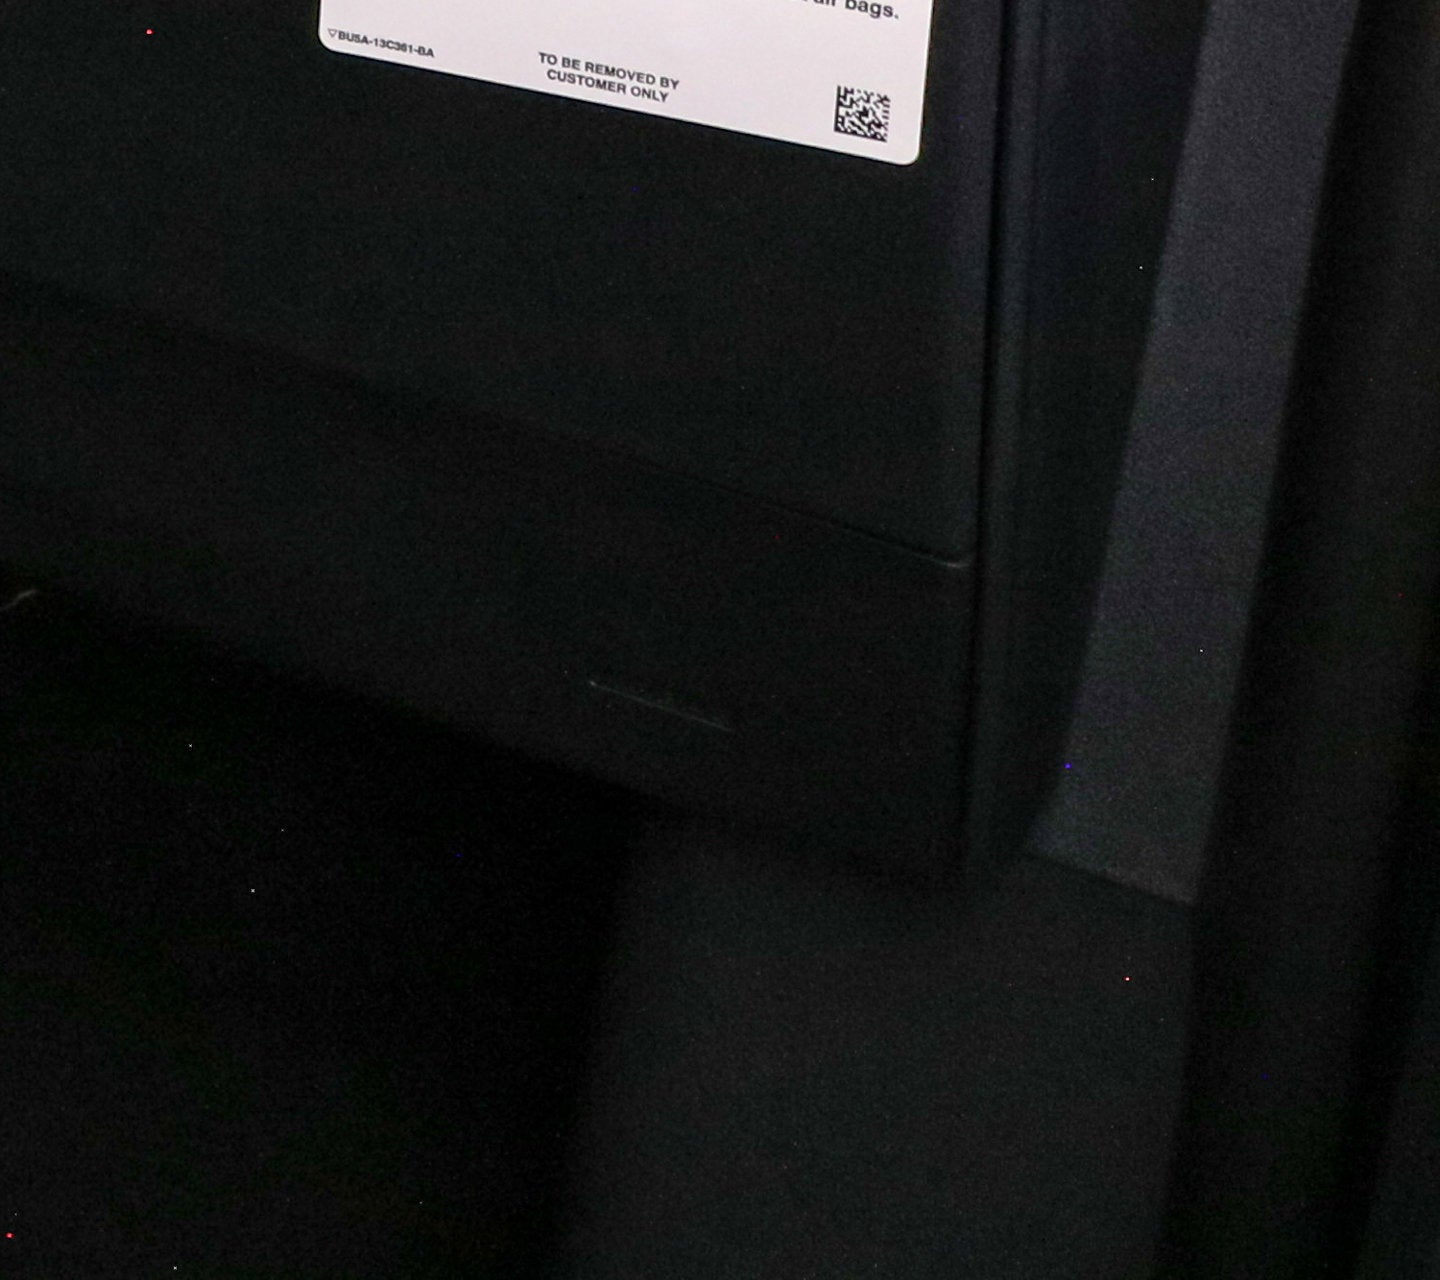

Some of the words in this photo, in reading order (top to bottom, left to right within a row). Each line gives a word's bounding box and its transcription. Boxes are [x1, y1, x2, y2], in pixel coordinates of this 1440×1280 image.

[538, 51, 558, 66] TO
[561, 56, 581, 71] BE
[584, 61, 656, 86] REMOVED
[659, 76, 680, 90] BY
[546, 68, 627, 95] CUSTOMER
[630, 85, 669, 103] ONLY
